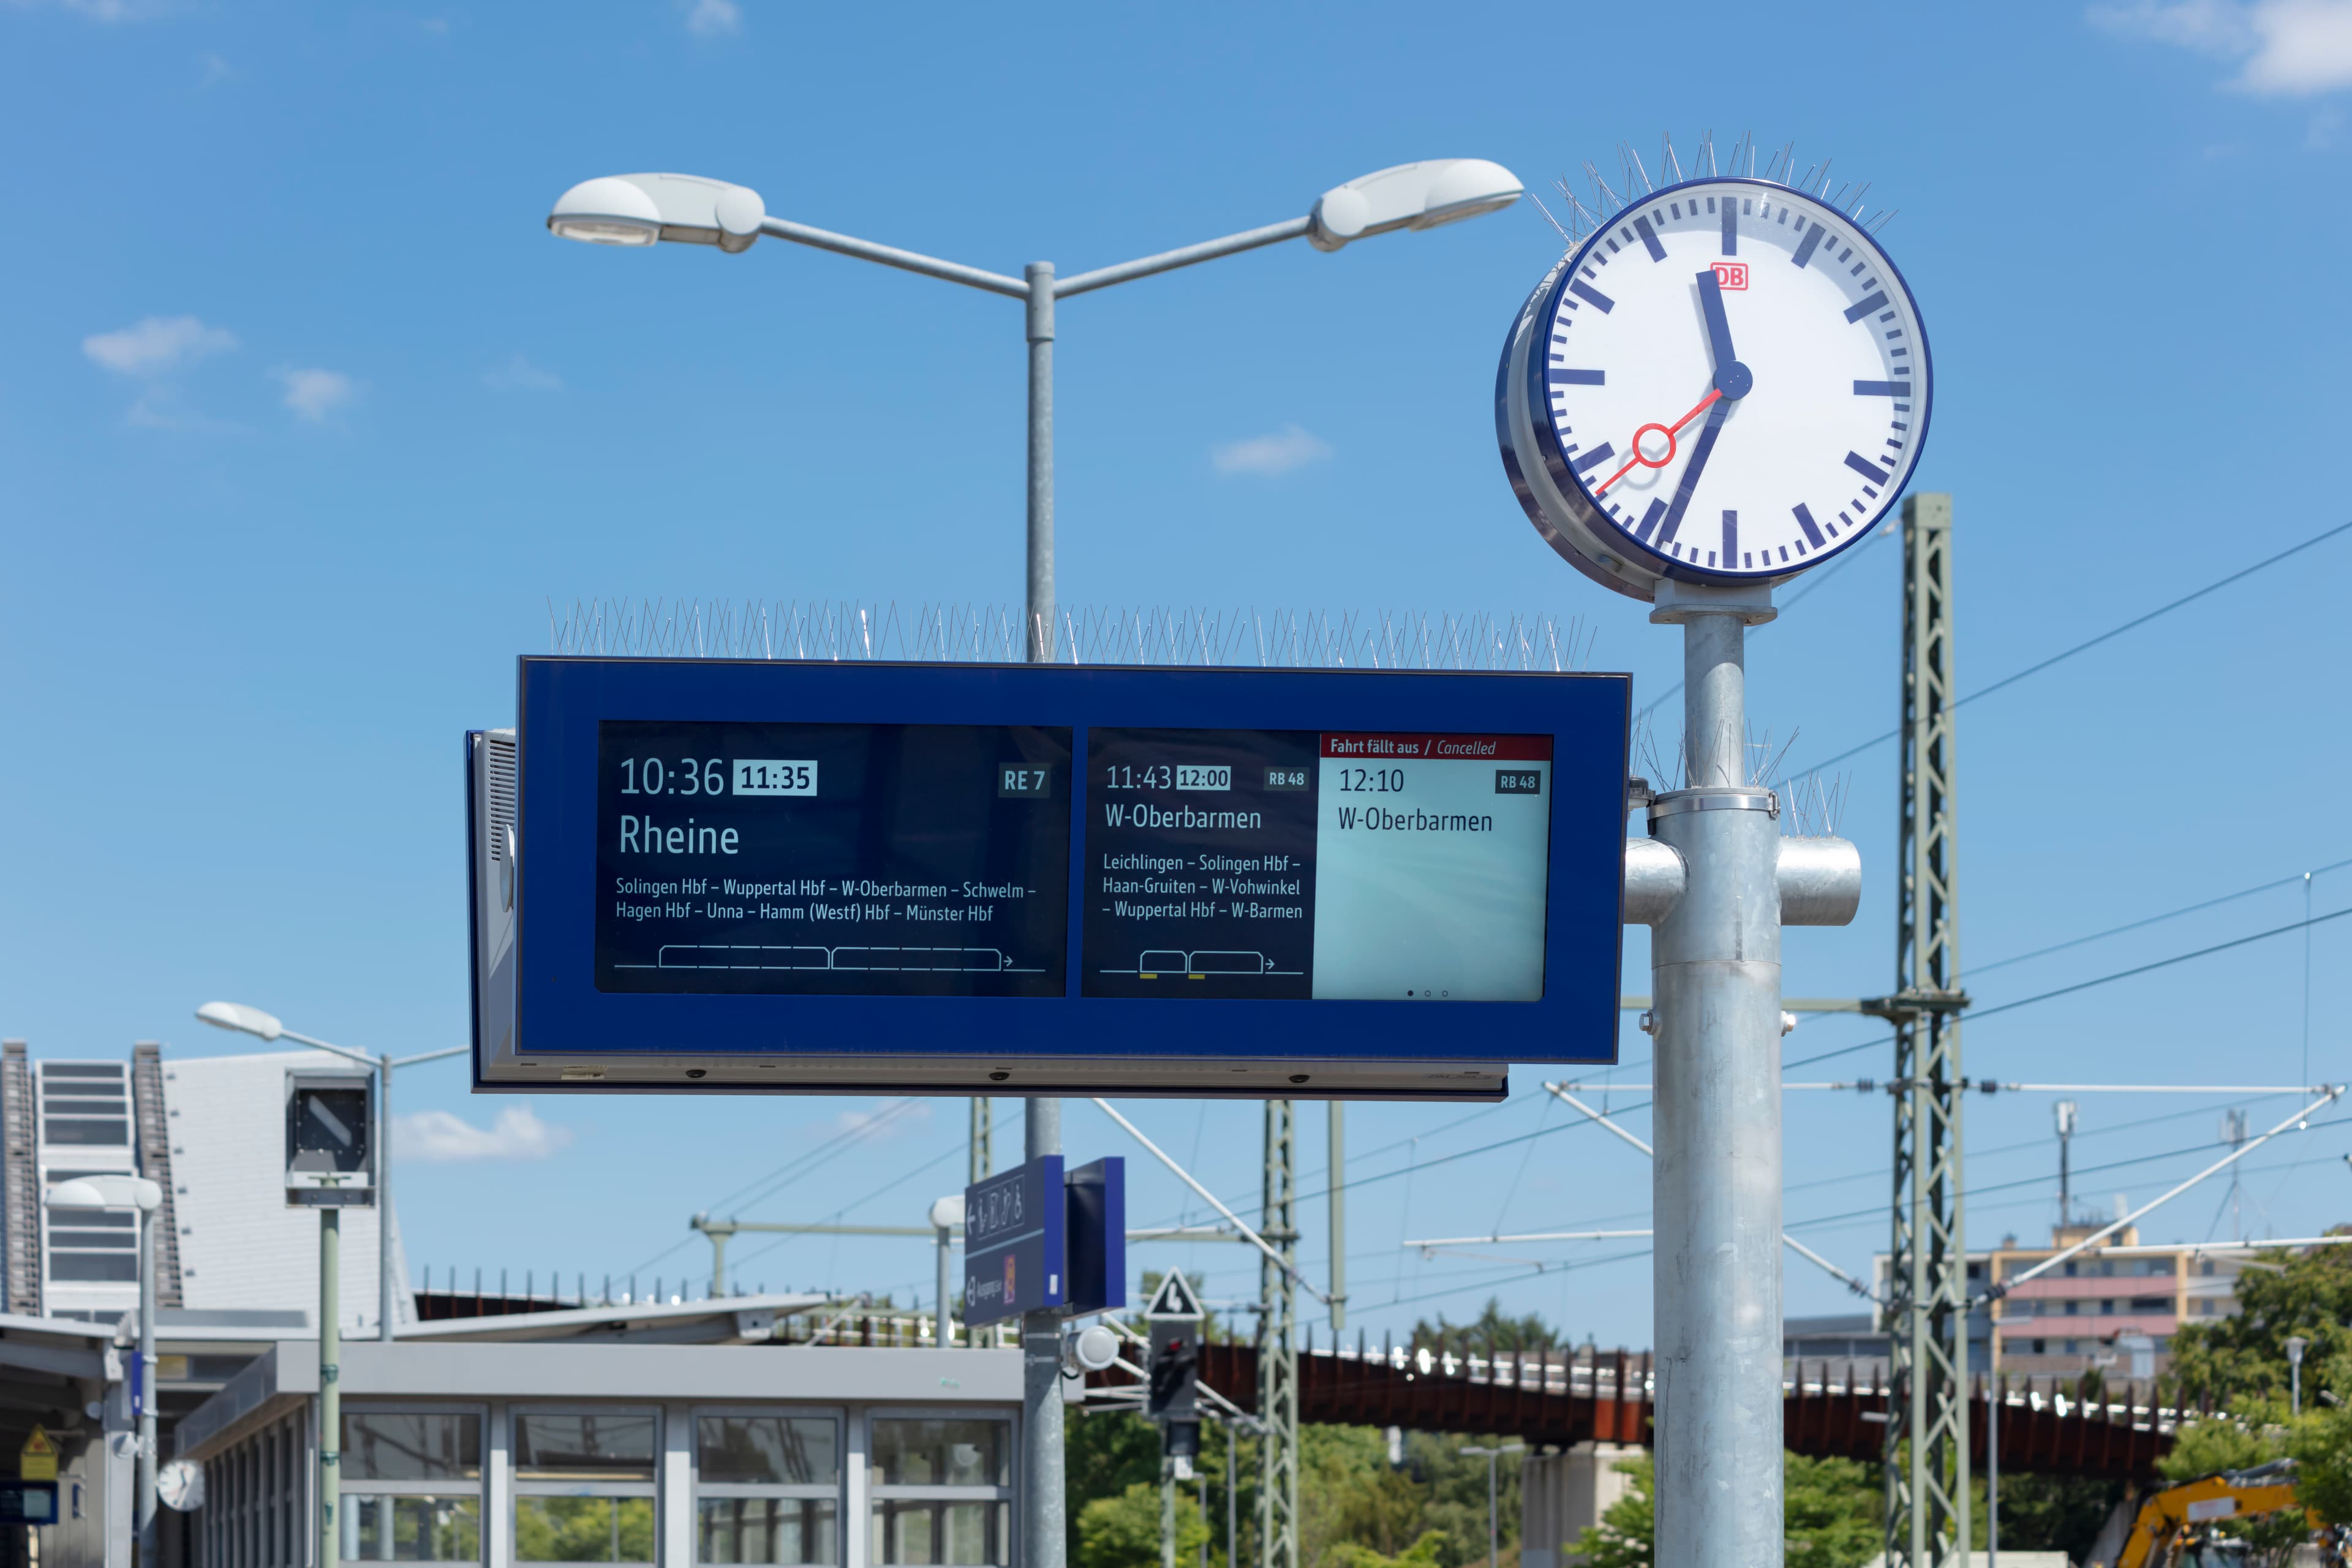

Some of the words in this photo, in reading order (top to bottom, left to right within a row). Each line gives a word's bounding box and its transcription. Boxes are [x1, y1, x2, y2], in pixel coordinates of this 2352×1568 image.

[1715, 266, 1744, 286] DB
[1331, 738, 1364, 753] Fahrt
[1366, 739, 1394, 753] fällt
[1397, 744, 1419, 754] aus
[1425, 740, 1431, 755] /
[1437, 740, 1496, 755] Cancelled
[621, 757, 724, 796] 10:36
[741, 766, 810, 790] 11:35
[1005, 770, 1028, 790] RE
[1033, 771, 1046, 790] 7
[1107, 765, 1171, 790] 11:43
[1180, 769, 1228, 787] 12:00
[1269, 772, 1285, 785] RB
[1288, 772, 1305, 786] 48
[1340, 769, 1404, 793] 12:10
[1501, 775, 1517, 788] RB
[1519, 775, 1536, 789] 48
[1106, 804, 1261, 829] W-Oberbarmen
[1338, 807, 1492, 832] W-Oberbarmen
[620, 815, 739, 854] Rheine
[1104, 853, 1183, 874] Leichlingen
[1199, 854, 1259, 875] Solingen
[1264, 855, 1289, 871] Hbf
[616, 877, 677, 898] Solingen
[682, 878, 707, 895] Hbf
[723, 878, 796, 899] Wuppertal
[801, 880, 826, 896] Hbf
[842, 880, 947, 897] W-Oberbarmen
[963, 881, 1023, 898] Schwelm
[1103, 876, 1196, 894] Haan-Gruiten
[1212, 878, 1300, 895] W-Vohwinkel
[616, 901, 661, 922] Hagen
[666, 902, 692, 918] Hbf
[707, 902, 743, 919] Unna
[760, 903, 804, 919] Hamm
[810, 902, 861, 922] (Westf)
[865, 904, 891, 920] Hbf
[907, 904, 964, 921] Münster
[968, 905, 993, 921] Hbf
[1115, 900, 1186, 921] Wuppertal
[1191, 901, 1216, 918] Hbf
[1231, 902, 1302, 919] W-Barmen
